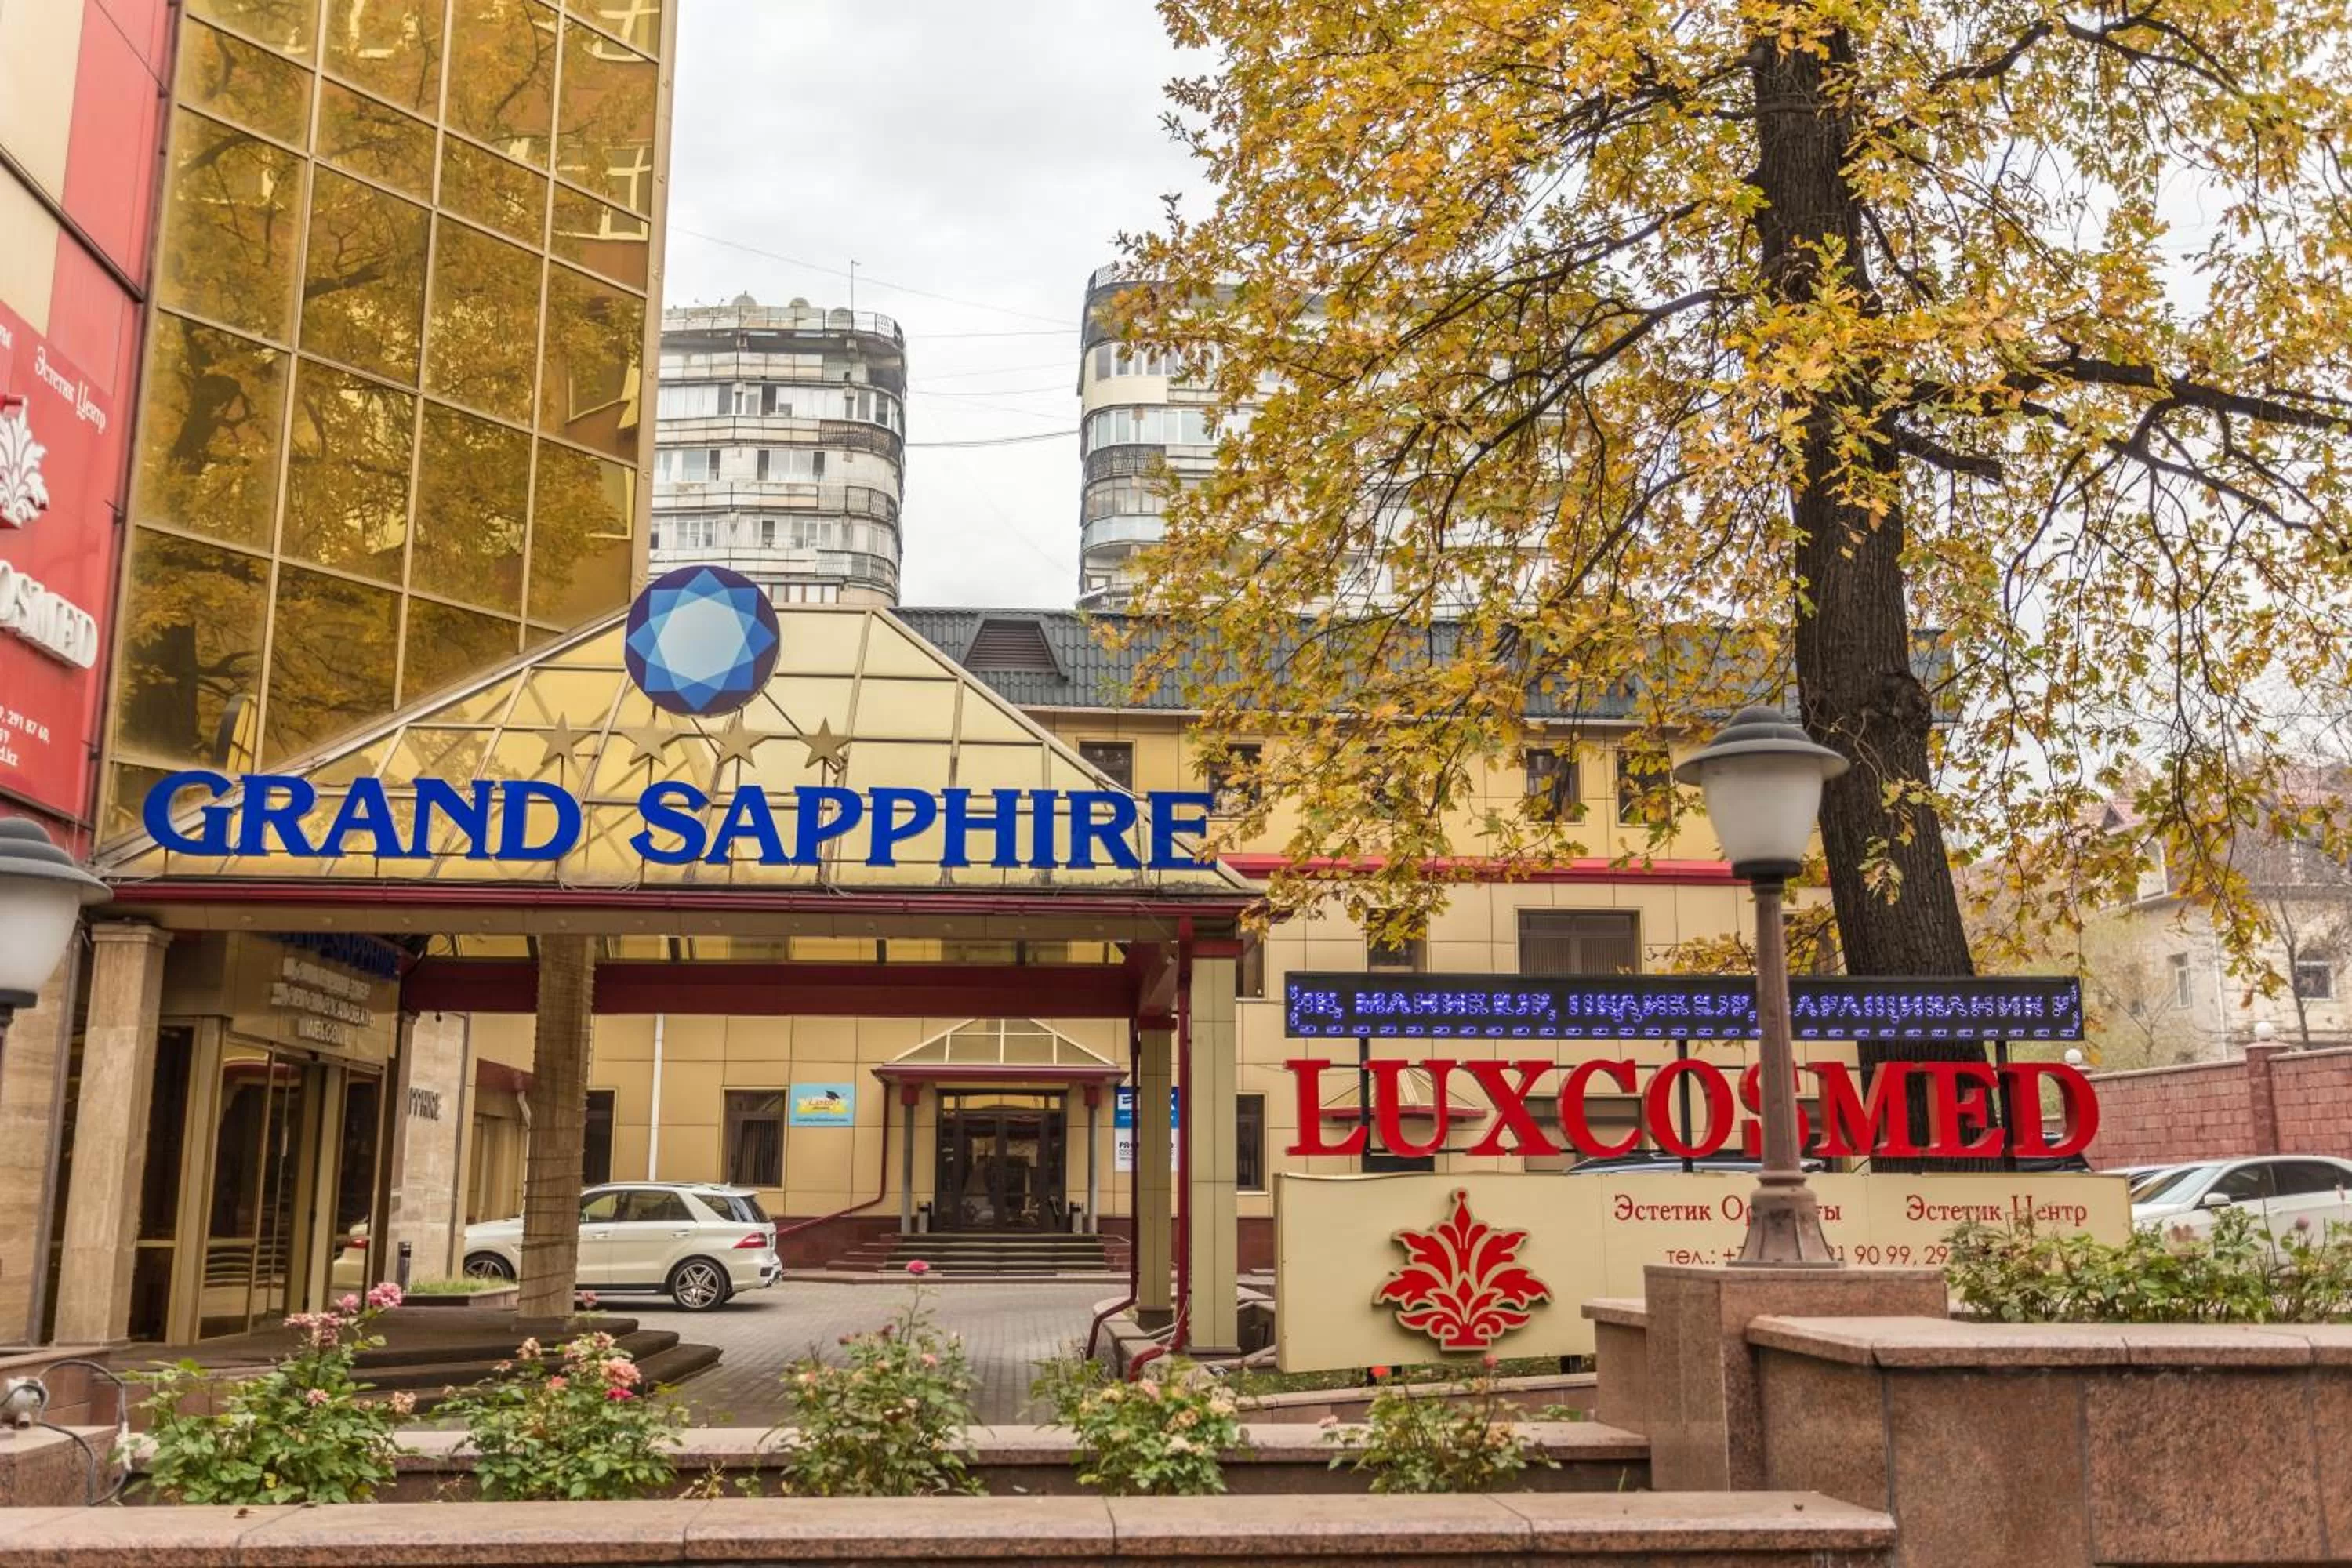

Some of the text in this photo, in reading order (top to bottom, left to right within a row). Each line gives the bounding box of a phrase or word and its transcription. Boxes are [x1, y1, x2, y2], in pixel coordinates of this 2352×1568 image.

[35, 344, 107, 435] Эстетик Центр
[142, 770, 1219, 870] GRAND SAPPHIRE
[1784, 995, 2044, 1024] АРАЩИВАНИЕ
[1613, 1193, 1712, 1221] Эстетик
[1905, 1193, 2088, 1227] Эстетик Центр
[1666, 1249, 1716, 1265] тел.:
[1854, 1245, 1881, 1265] 90
